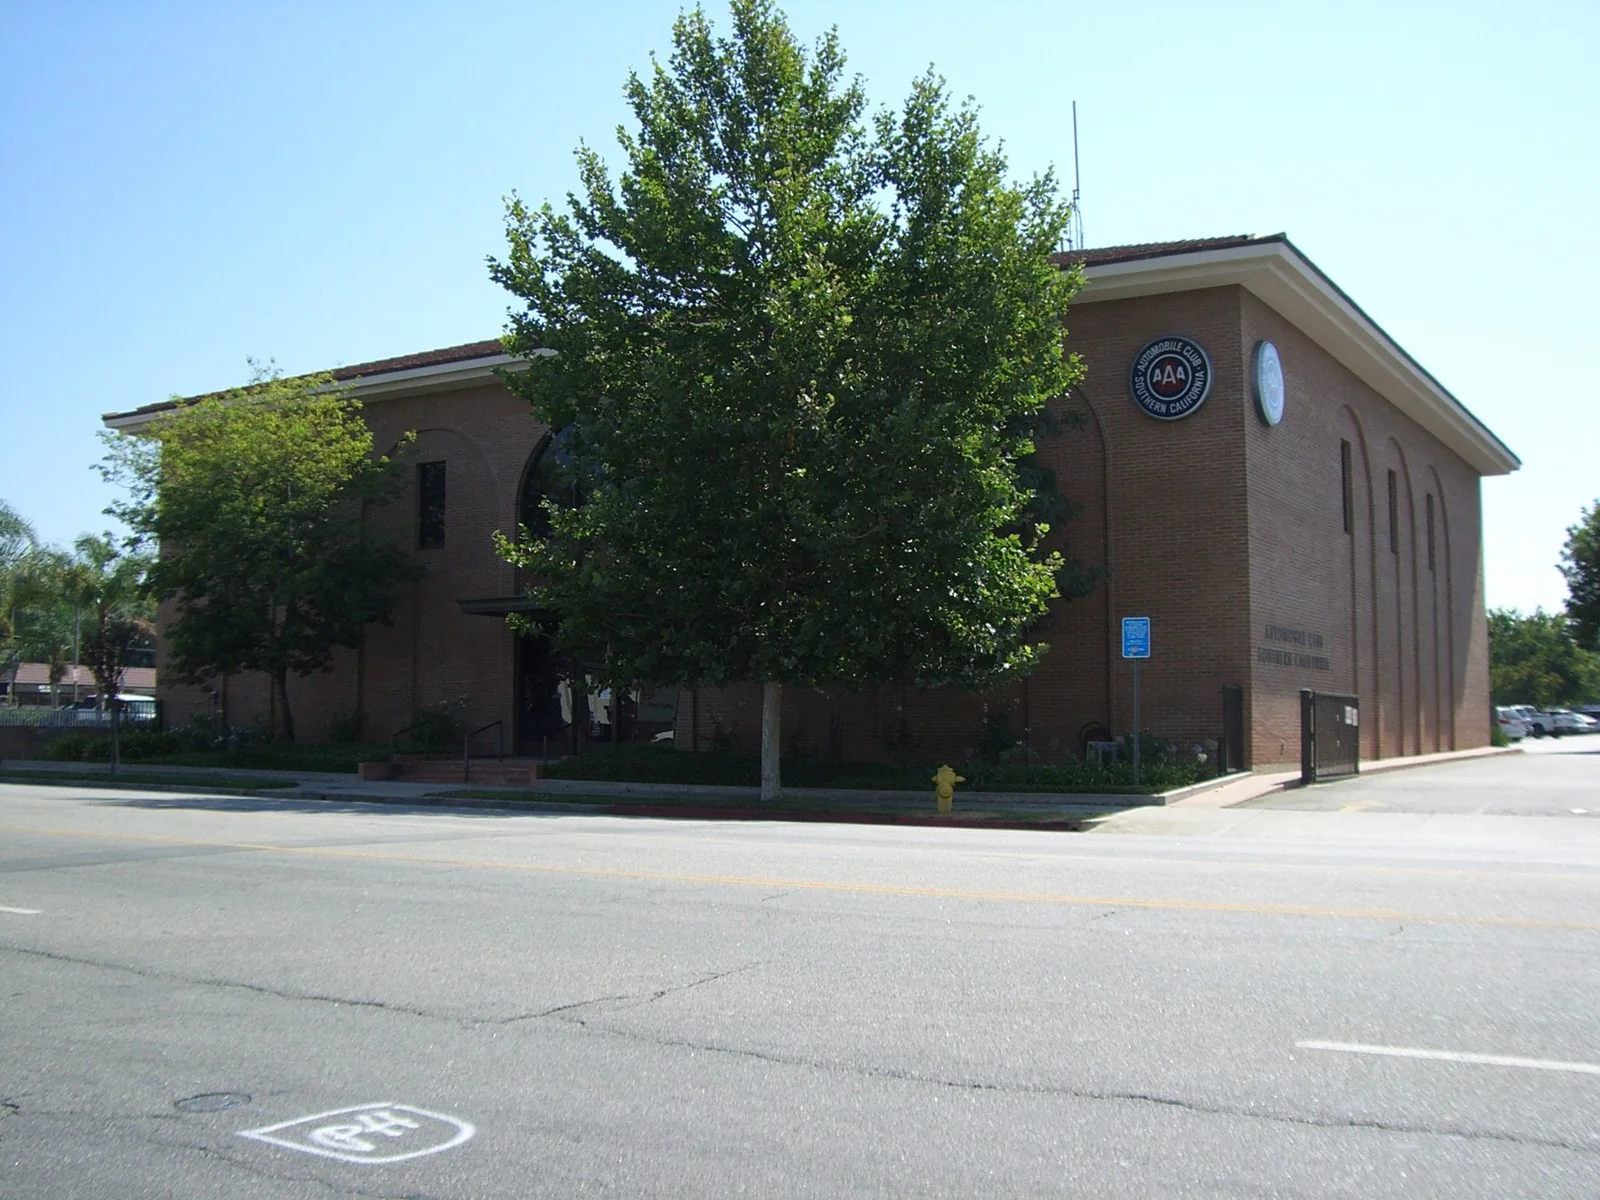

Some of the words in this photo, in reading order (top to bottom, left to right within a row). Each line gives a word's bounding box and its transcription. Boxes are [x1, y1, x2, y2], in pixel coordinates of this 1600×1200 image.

[1137, 341, 1183, 371] AUTOMOBILE
[1183, 346, 1202, 366] CLUB
[1152, 365, 1186, 385] AAA
[1135, 376, 1167, 413] SOUTHERN
[1169, 370, 1205, 413] CALIFORNIA
